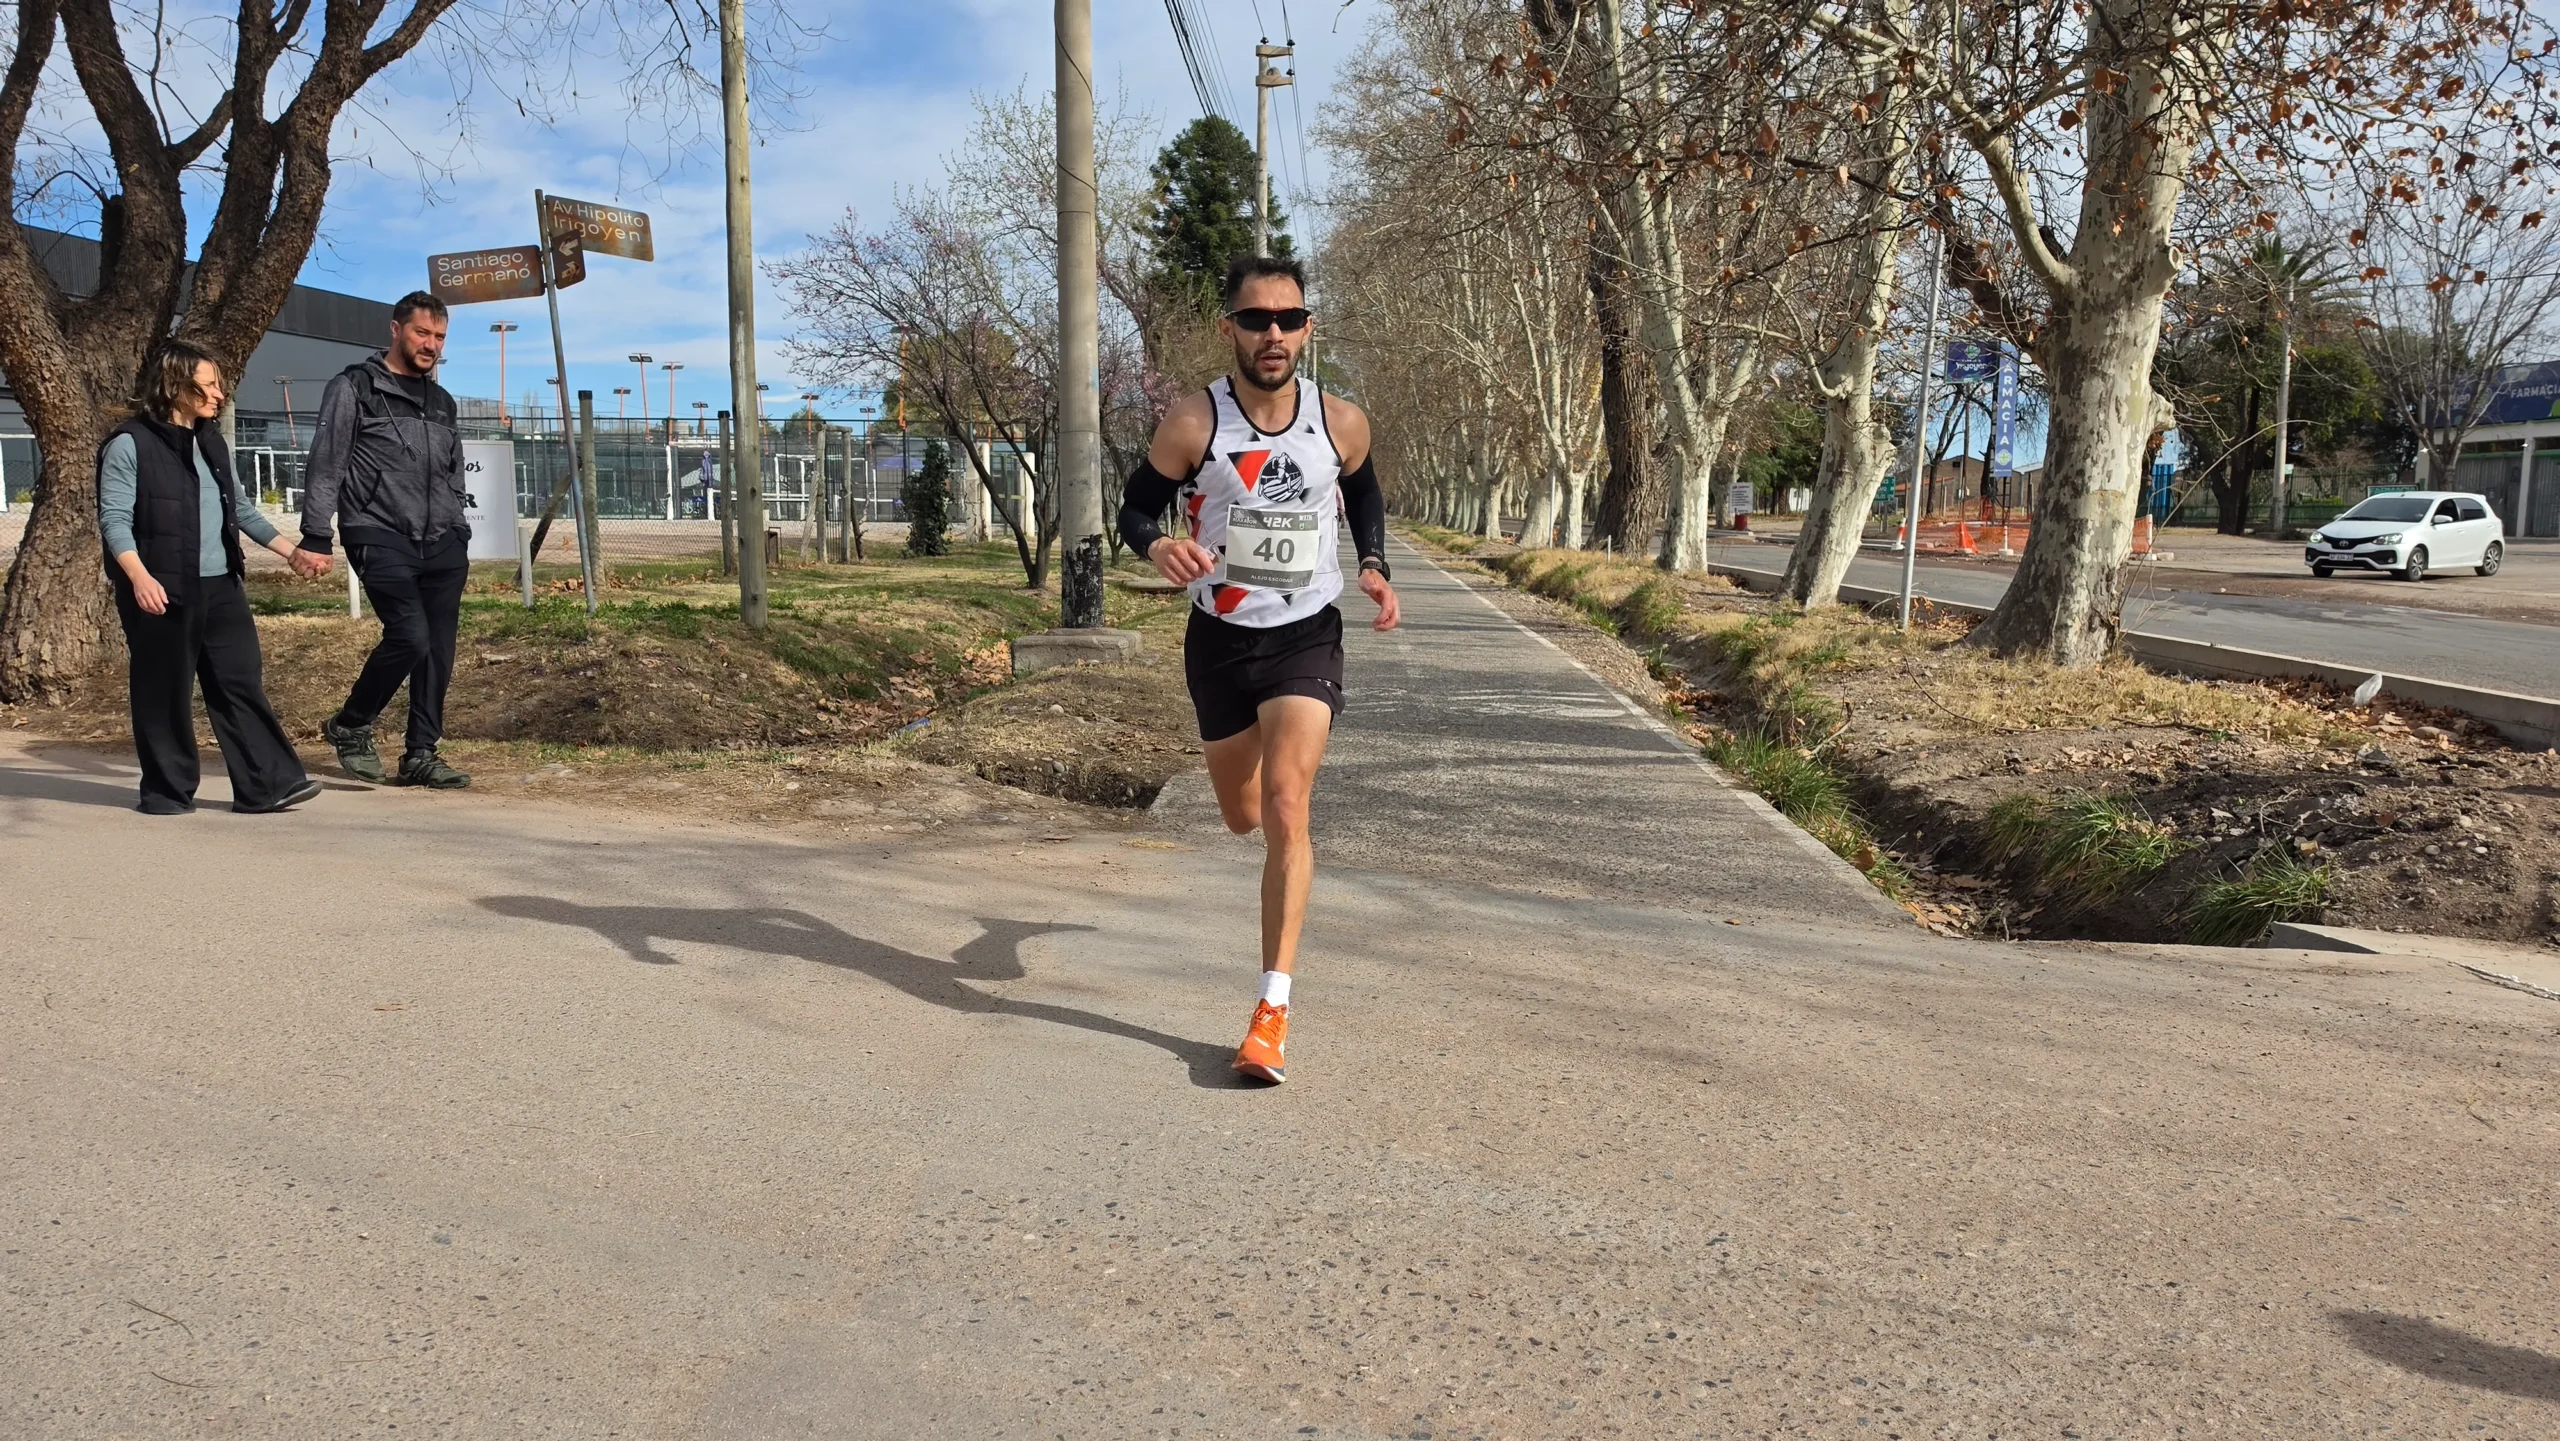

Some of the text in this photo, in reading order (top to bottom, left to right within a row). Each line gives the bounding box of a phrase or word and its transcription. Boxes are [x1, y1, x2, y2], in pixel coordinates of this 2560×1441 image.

[576, 204, 645, 228] Hipolito
[553, 214, 641, 243] Irigoyen
[437, 252, 523, 272] Santiago
[439, 263, 531, 288] Germanó
[2000, 360, 2014, 445] ARMACIA
[464, 460, 485, 473] os
[1263, 516, 1293, 528] 42K
[1252, 537, 1295, 564] 40
